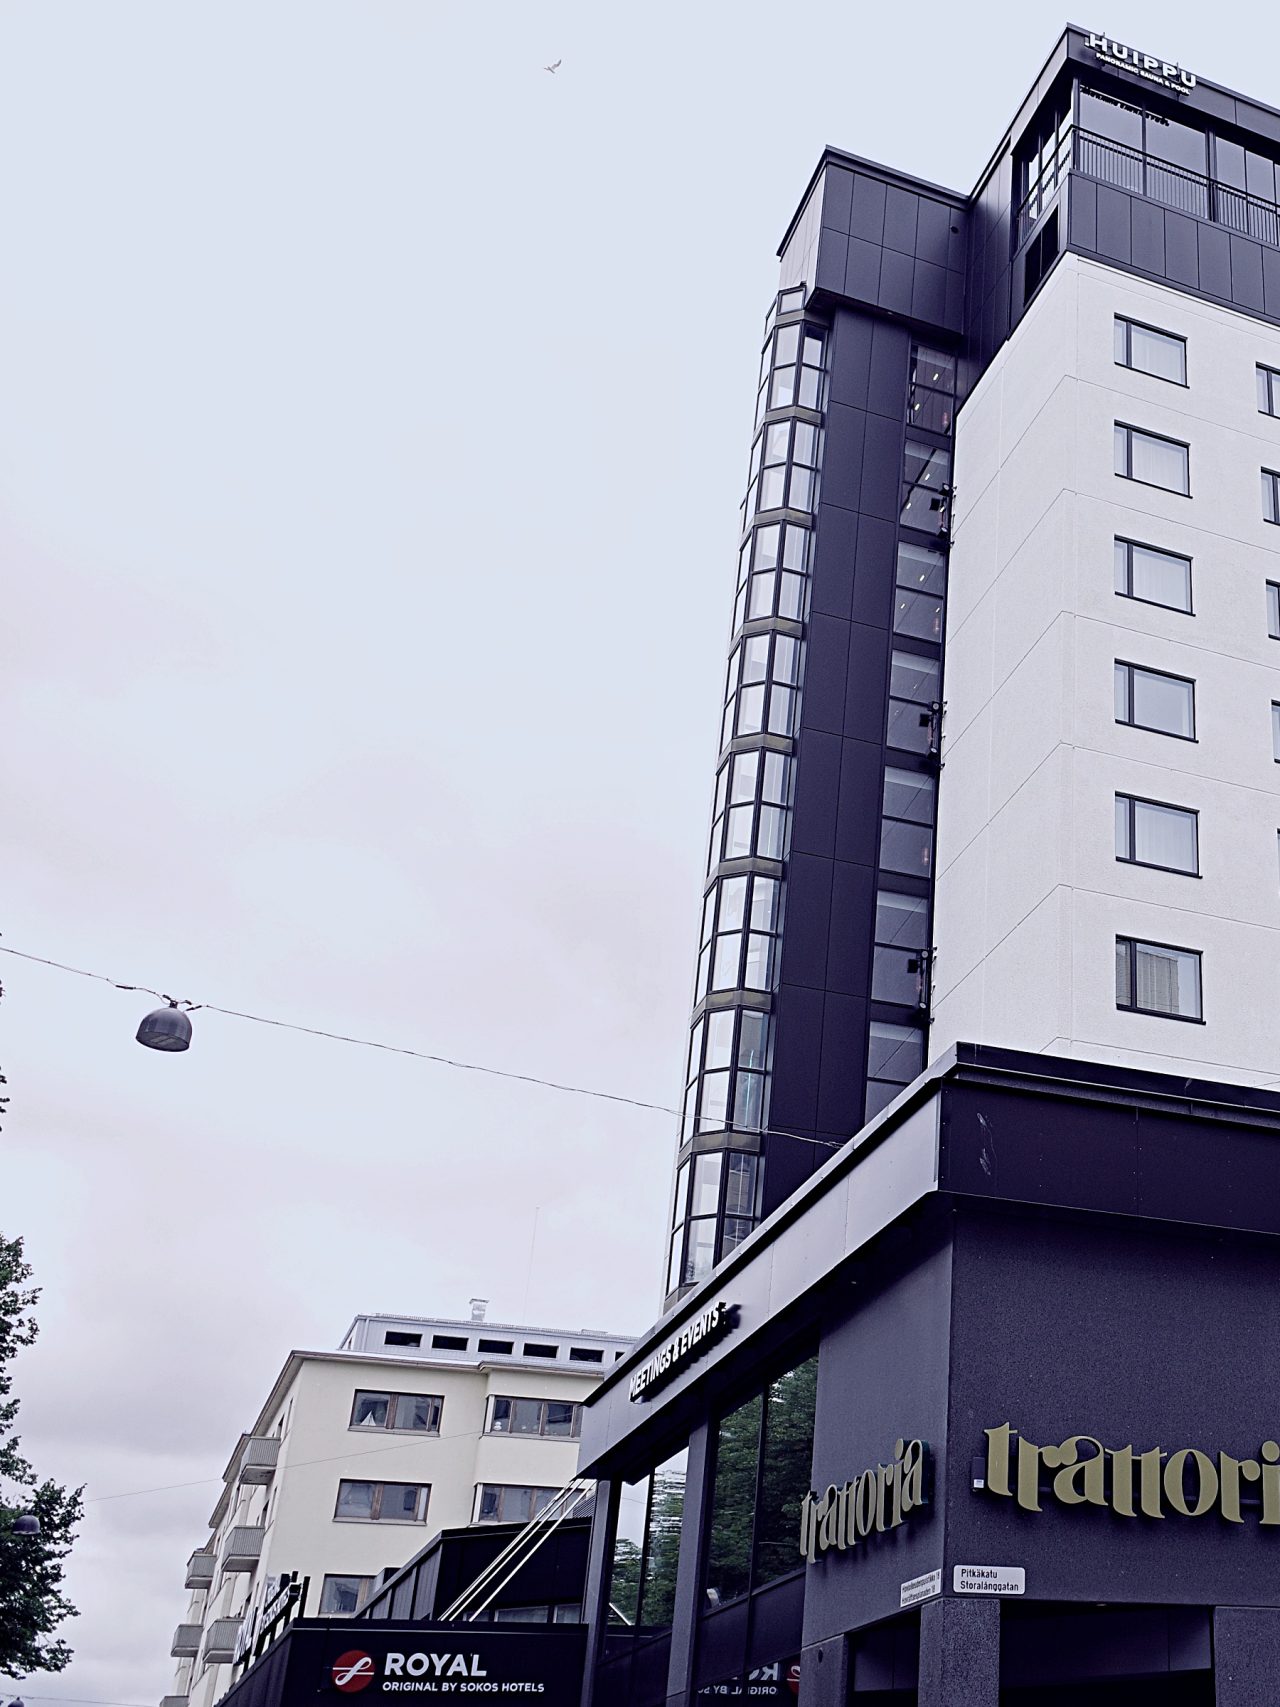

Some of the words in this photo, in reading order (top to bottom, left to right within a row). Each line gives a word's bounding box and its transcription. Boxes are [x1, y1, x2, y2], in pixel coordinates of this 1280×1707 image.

[1089, 33, 1196, 88] HUIPPU
[1096, 53, 1139, 76] PANORAMIC
[1171, 83, 1191, 96] POOL
[629, 1343, 674, 1401] MEETINGS
[680, 1307, 720, 1356] EVENTS
[800, 1438, 924, 1564] trattoria
[960, 1580, 1019, 1592] Storalånggatan
[961, 1568, 998, 1579] Pitkäkatu
[384, 1652, 487, 1677] ROYAL
[382, 1681, 438, 1692] ORIGINAL
[441, 1682, 457, 1692] BY
[460, 1682, 499, 1693] SOKOS
[501, 1683, 545, 1693] HOTELS
